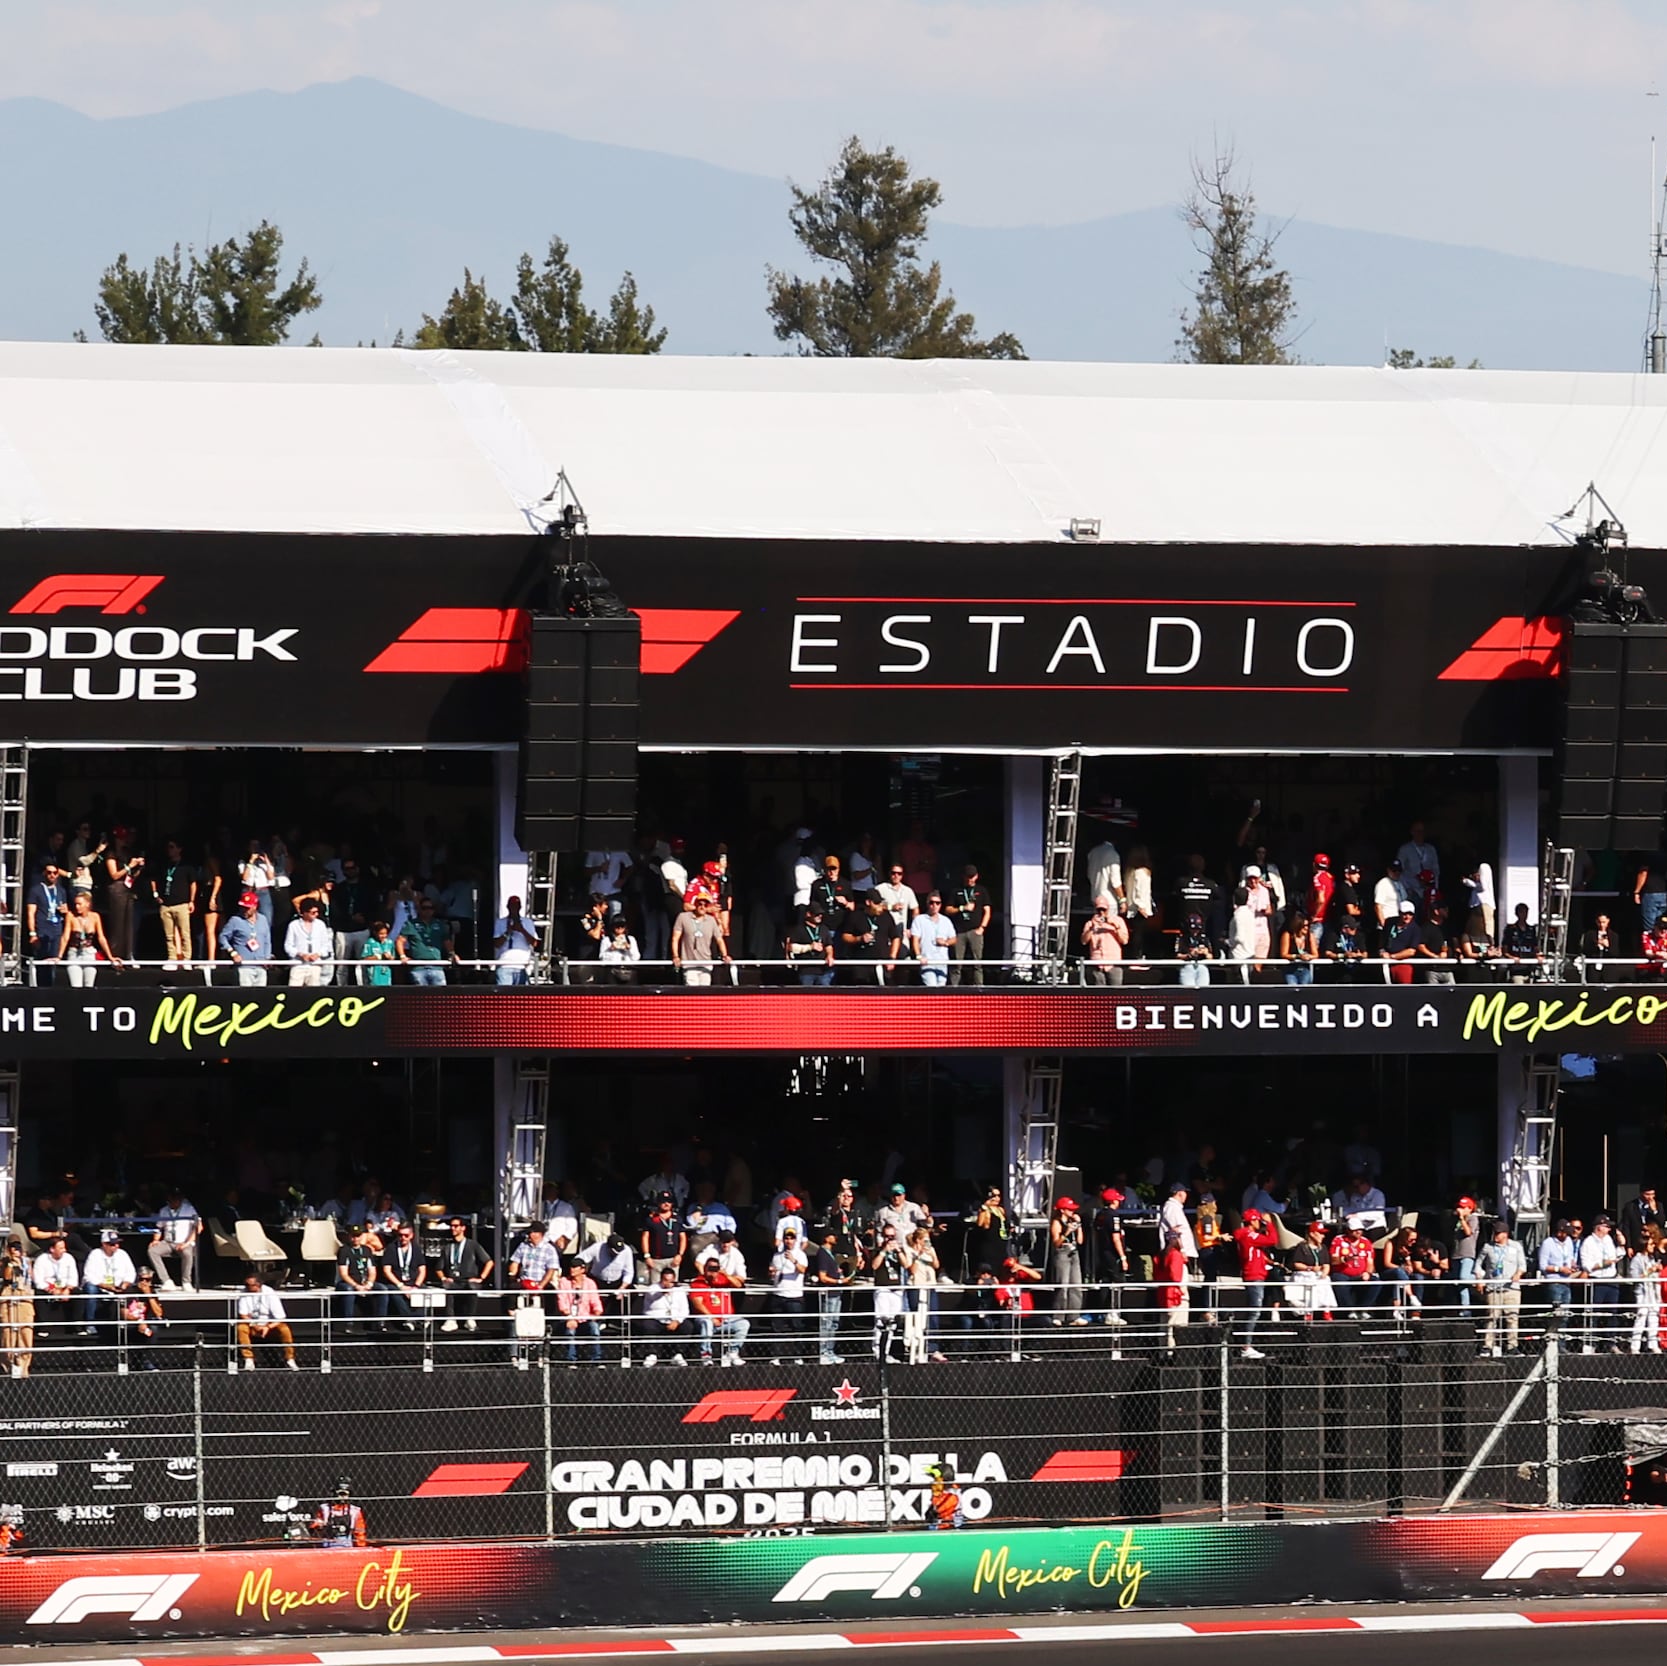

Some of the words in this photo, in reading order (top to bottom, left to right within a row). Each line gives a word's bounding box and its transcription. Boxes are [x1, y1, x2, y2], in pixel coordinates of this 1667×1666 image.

[790, 613, 1356, 678] ESTADIO
[2, 1007, 56, 1032] ME
[83, 1007, 136, 1032] TO
[149, 993, 385, 1050] Mexico
[1116, 1004, 1394, 1030] BIENVENIDO
[1417, 1004, 1440, 1029] A
[811, 1405, 880, 1420] Heineken
[730, 1432, 817, 1445] FORMULA
[551, 1460, 686, 1492] GRAN
[692, 1454, 872, 1490] PREMIO
[75, 1506, 115, 1519] MSC
[164, 1506, 234, 1519] crypt.com
[568, 1493, 738, 1528] CIUDAD
[744, 1492, 804, 1524] DE
[974, 1544, 1080, 1598] Mexico
[1088, 1528, 1150, 1608] City
[236, 1568, 348, 1621] Mexico
[354, 1549, 421, 1632] City
